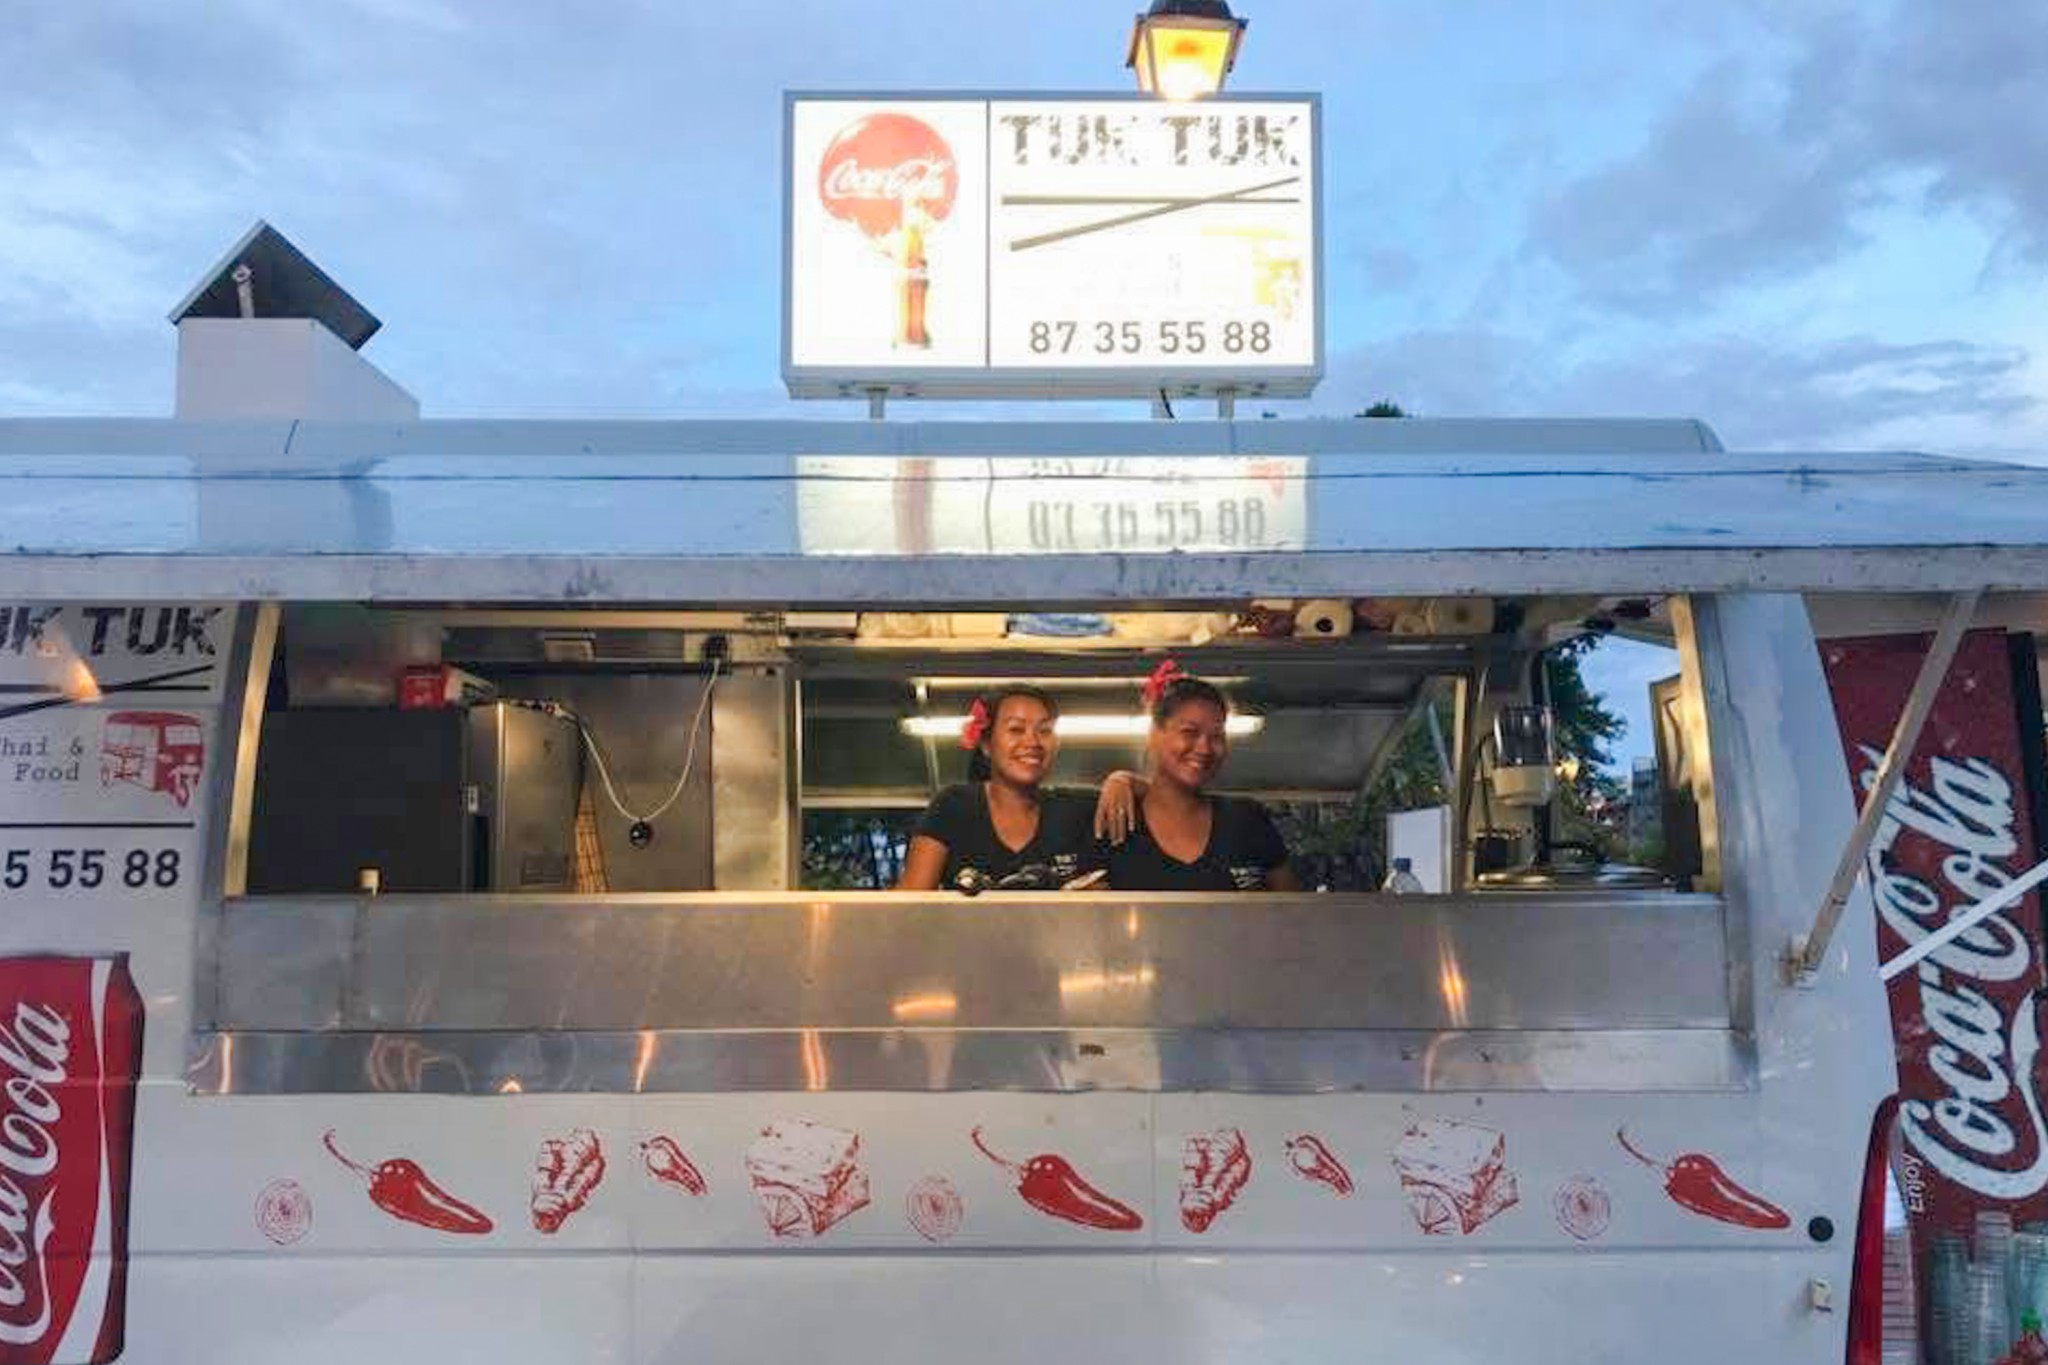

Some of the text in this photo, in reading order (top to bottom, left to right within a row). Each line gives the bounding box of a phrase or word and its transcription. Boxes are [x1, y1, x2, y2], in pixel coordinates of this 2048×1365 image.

[1000, 115, 1299, 166] TUK TUK
[1030, 321, 1272, 354] 87 35 55 88
[82, 607, 222, 656] TUK
[15, 763, 80, 782] Food
[48, 849, 105, 889] 55
[124, 849, 180, 889] 88
[1901, 1153, 1925, 1213] Enjoy
